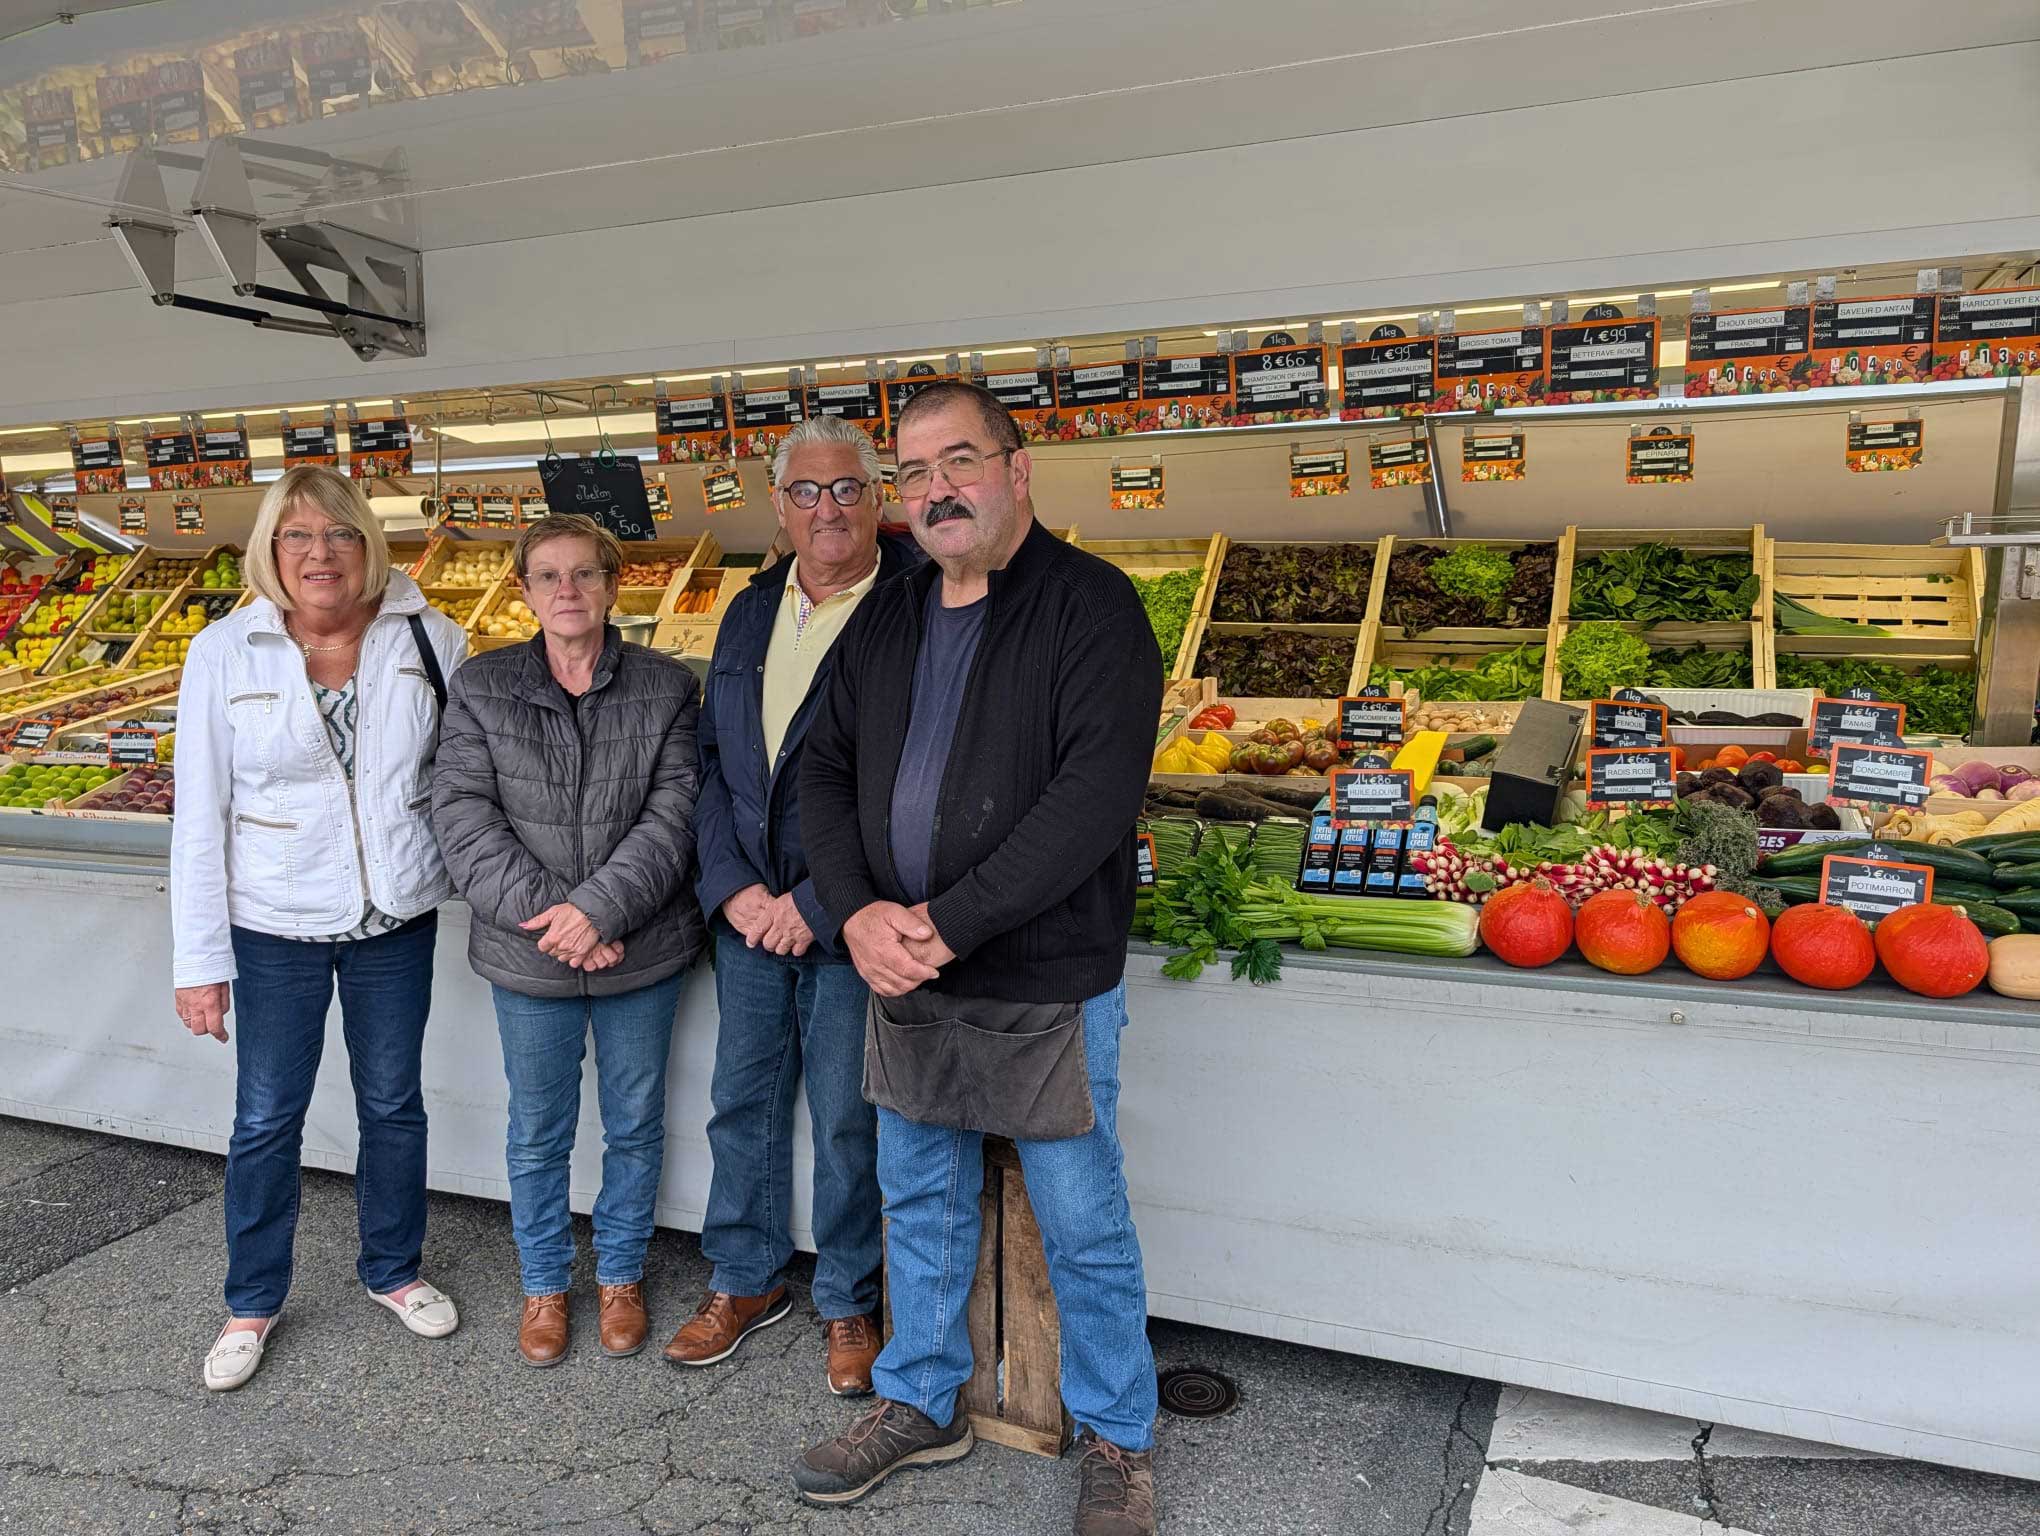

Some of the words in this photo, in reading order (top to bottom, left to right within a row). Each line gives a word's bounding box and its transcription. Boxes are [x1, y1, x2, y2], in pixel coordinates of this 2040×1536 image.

[1962, 299, 2001, 308] HARICOT
[2003, 296, 2027, 305] VERT
[1840, 307, 1874, 316] SAVEUR
[1875, 306, 1882, 314] D
[1883, 304, 1912, 313] ANTAN
[1718, 319, 1746, 328] CHOUX
[1747, 315, 1783, 326] BROCOLI
[1378, 326, 1397, 337] 1kg
[1270, 334, 1287, 345] 1kg
[1460, 339, 1489, 348] GROSSE
[1491, 336, 1521, 345] TOMATE
[1572, 349, 1615, 359] BETTERAVE
[1617, 346, 1644, 355] RONDE
[1348, 369, 1387, 378] BETTERAVE
[1387, 364, 1431, 374] CRAPAUDINE
[1243, 374, 1286, 384] CHAMPIGNON
[1297, 370, 1317, 378] PARIS
[576, 484, 612, 501] Melon
[1364, 686, 1380, 697] 1kg
[1624, 690, 1641, 703] 1kg
[1850, 687, 1871, 701] 1kg
[1616, 720, 1644, 729] FENOUIL
[1843, 719, 1873, 729] PANAIS
[1873, 738, 1893, 746] Pièce
[1607, 768, 1631, 776] RADIS
[1632, 767, 1654, 775] ROSE
[1855, 765, 1910, 778] CONCOMBRE
[1349, 788, 1370, 796] HUILE
[1854, 785, 1885, 794] FRANCE
[1315, 825, 1333, 834] terra
[1314, 832, 1332, 841] creta
[1345, 833, 1363, 842] creta
[1379, 831, 1397, 839] terra
[1411, 831, 1429, 840] terra
[1378, 837, 1396, 845] creta
[1410, 838, 1428, 847] creta
[1874, 844, 1881, 853] la
[1867, 851, 1889, 860] Pièce
[1851, 881, 1913, 895] POTIMARRON
[1848, 903, 1880, 911] FRANCE
